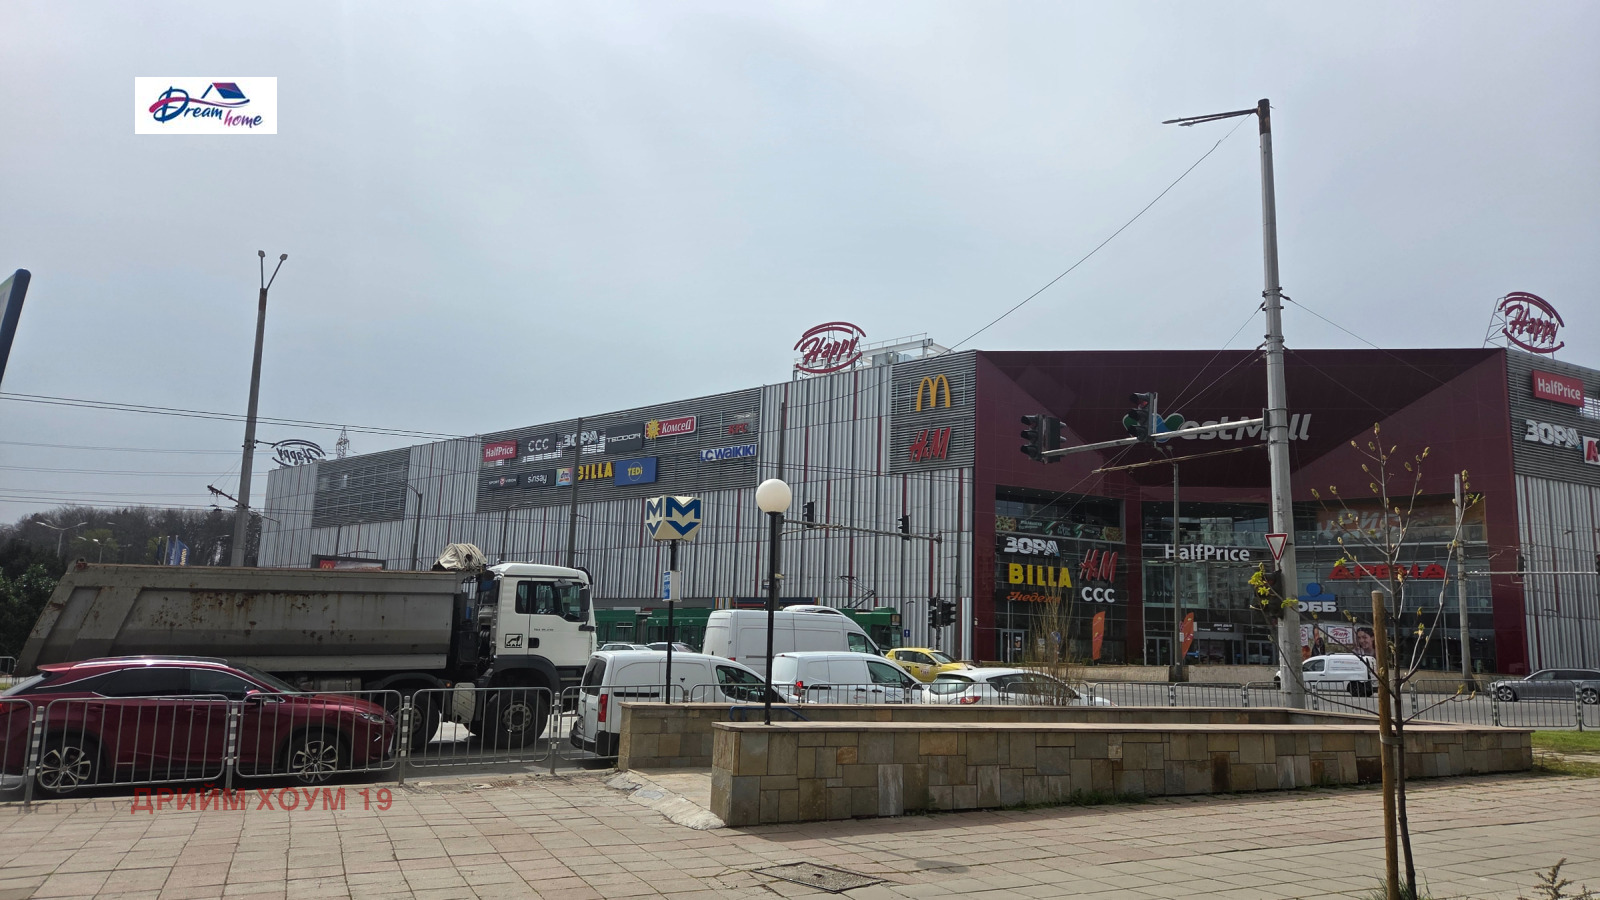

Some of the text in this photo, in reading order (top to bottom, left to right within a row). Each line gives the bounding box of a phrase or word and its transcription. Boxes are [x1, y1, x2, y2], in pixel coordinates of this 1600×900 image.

[1505, 304, 1559, 344] Happy
[800, 337, 859, 365] Happy
[1538, 377, 1581, 400] HalfPrice
[728, 423, 748, 435] KFC
[1525, 419, 1581, 449] ЗОРА
[485, 446, 513, 458] HalfPrice
[528, 438, 549, 452] CCC
[909, 427, 951, 462] H&M
[700, 450, 714, 461] LC
[527, 474, 548, 484] sinsay
[1004, 536, 1060, 556] ЗОРА
[1165, 544, 1250, 561] HalfPrice
[1009, 563, 1072, 588] BILLA
[1080, 549, 1118, 583] H&M
[1081, 586, 1115, 603] CCC
